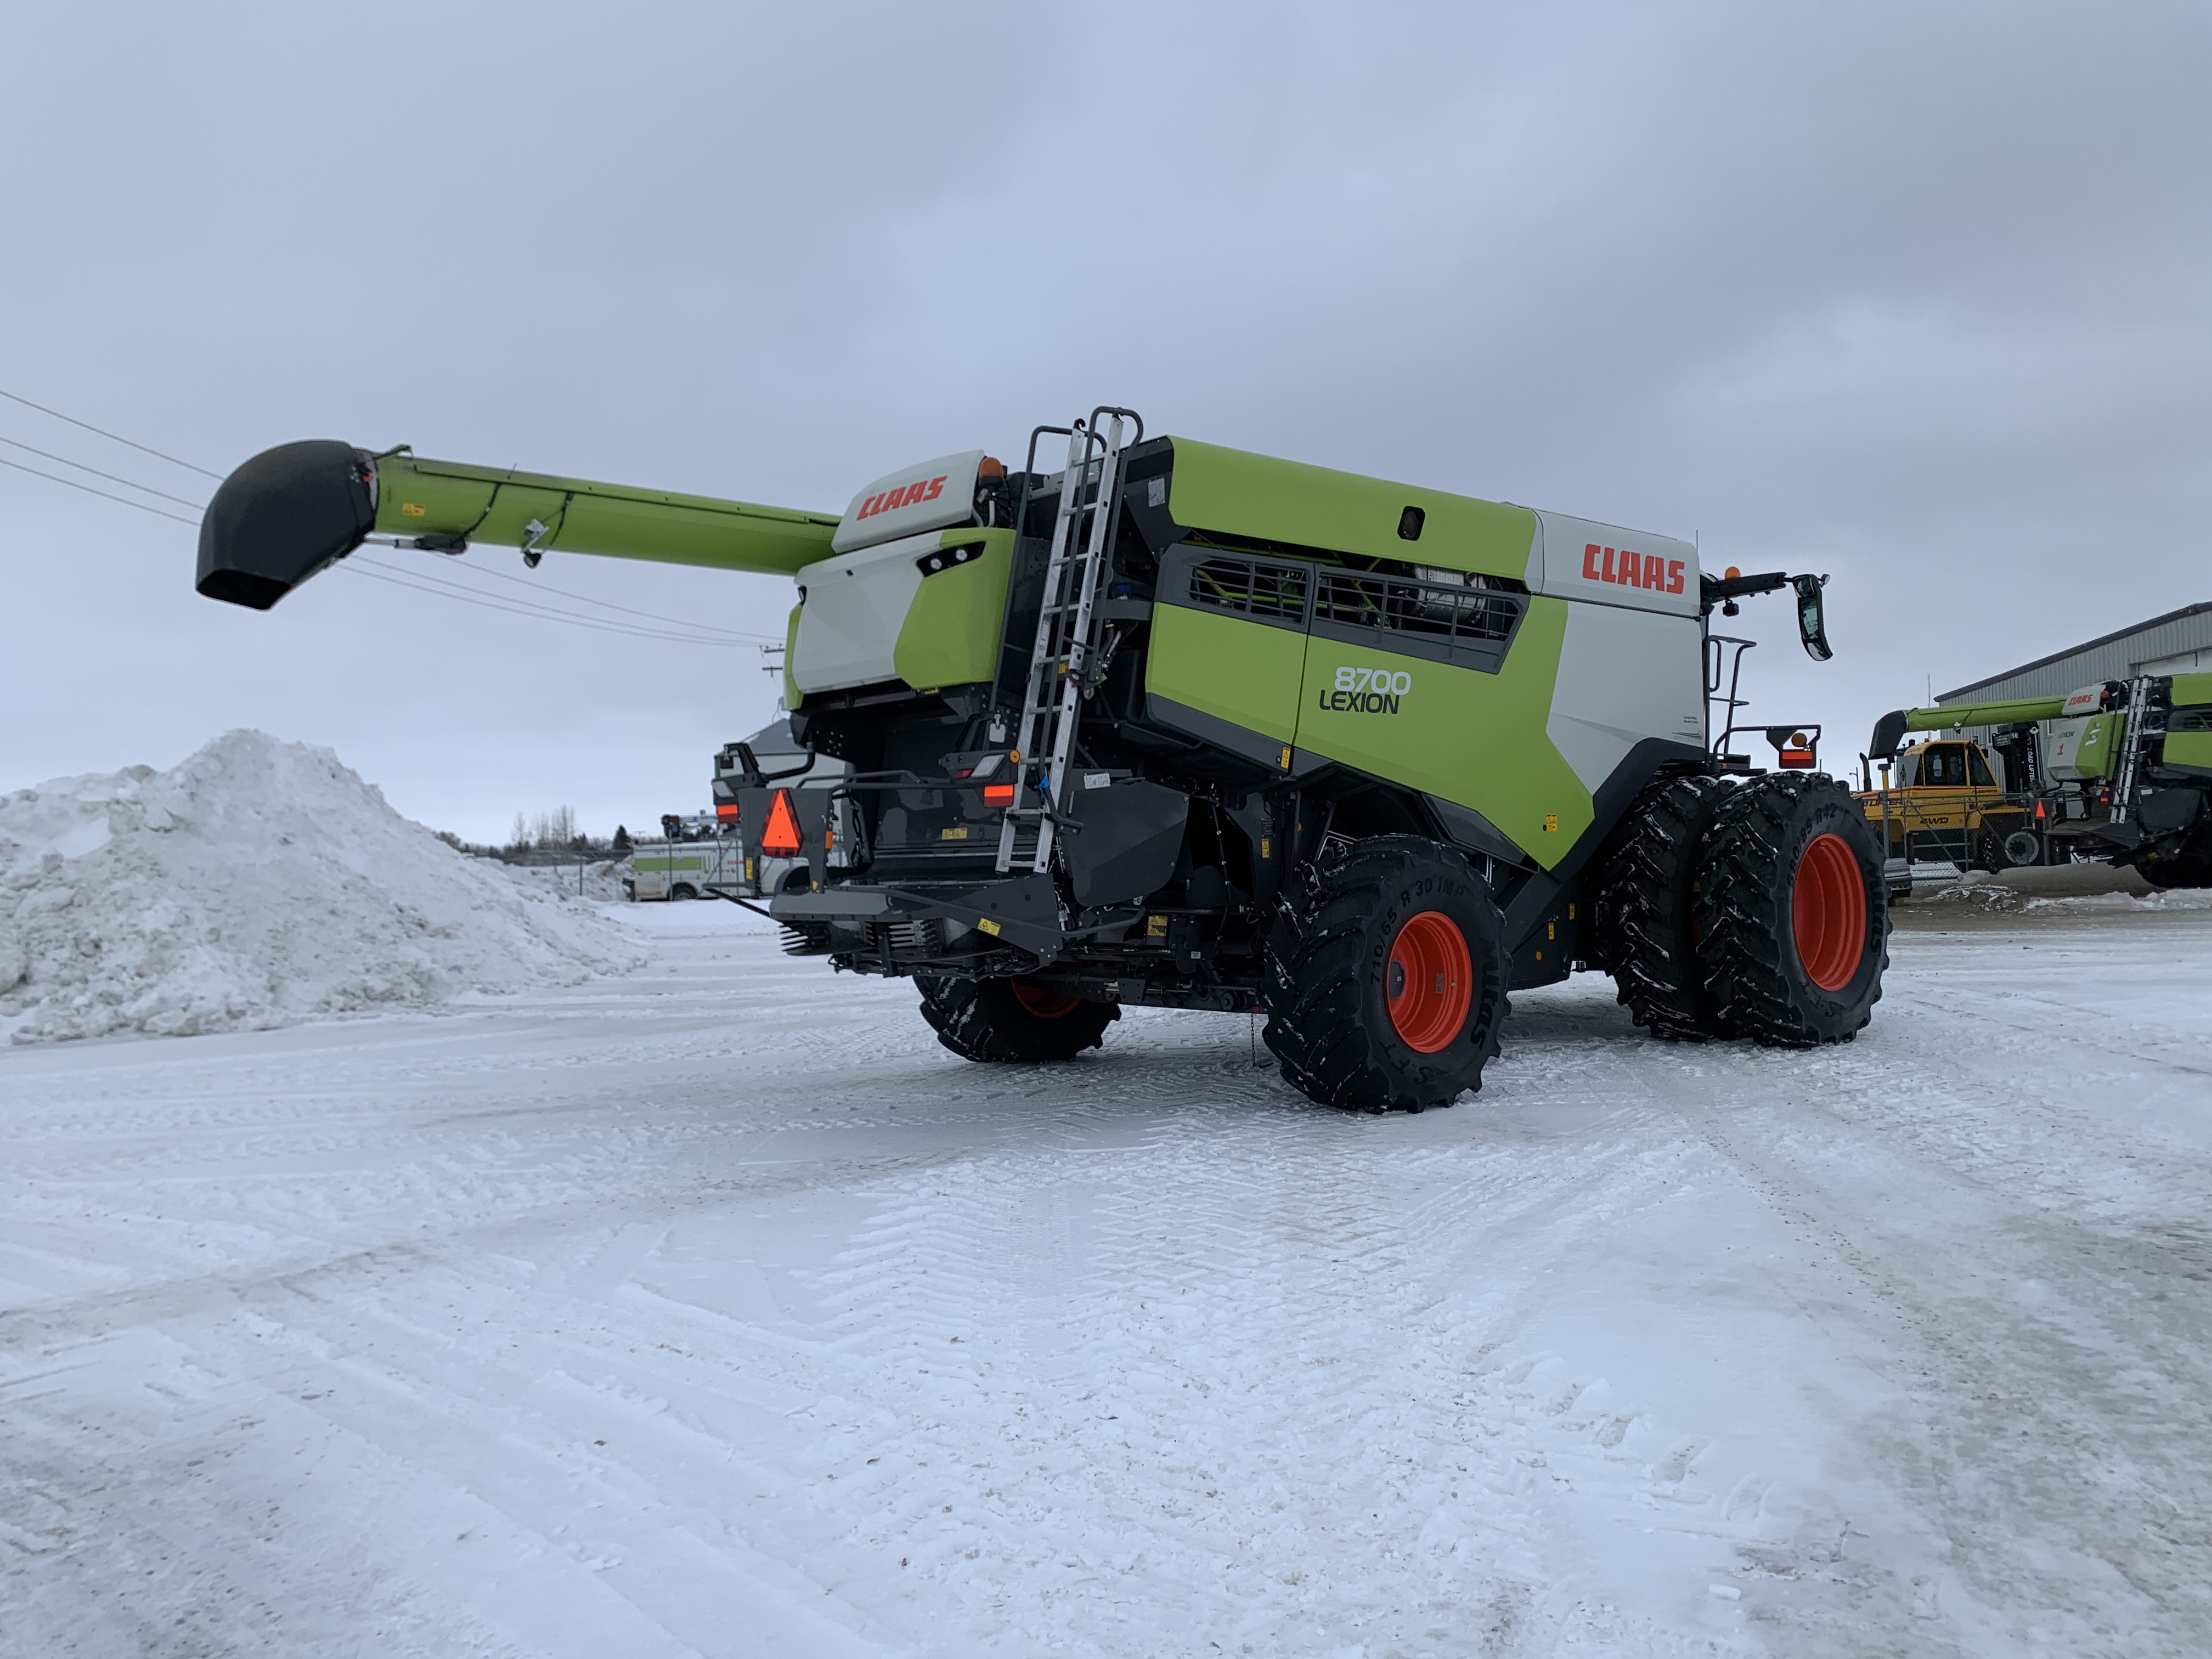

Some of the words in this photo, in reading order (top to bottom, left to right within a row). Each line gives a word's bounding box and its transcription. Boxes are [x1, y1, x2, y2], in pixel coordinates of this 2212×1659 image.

[856, 476, 947, 521] CLAAS
[1582, 544, 1685, 594] CLAAS
[1334, 667, 1411, 695] 8700
[1319, 690, 1400, 714] LEXION
[2068, 694, 2094, 706] CLAAS
[1370, 906, 1397, 985] 710/65
[1415, 877, 1433, 896] 30
